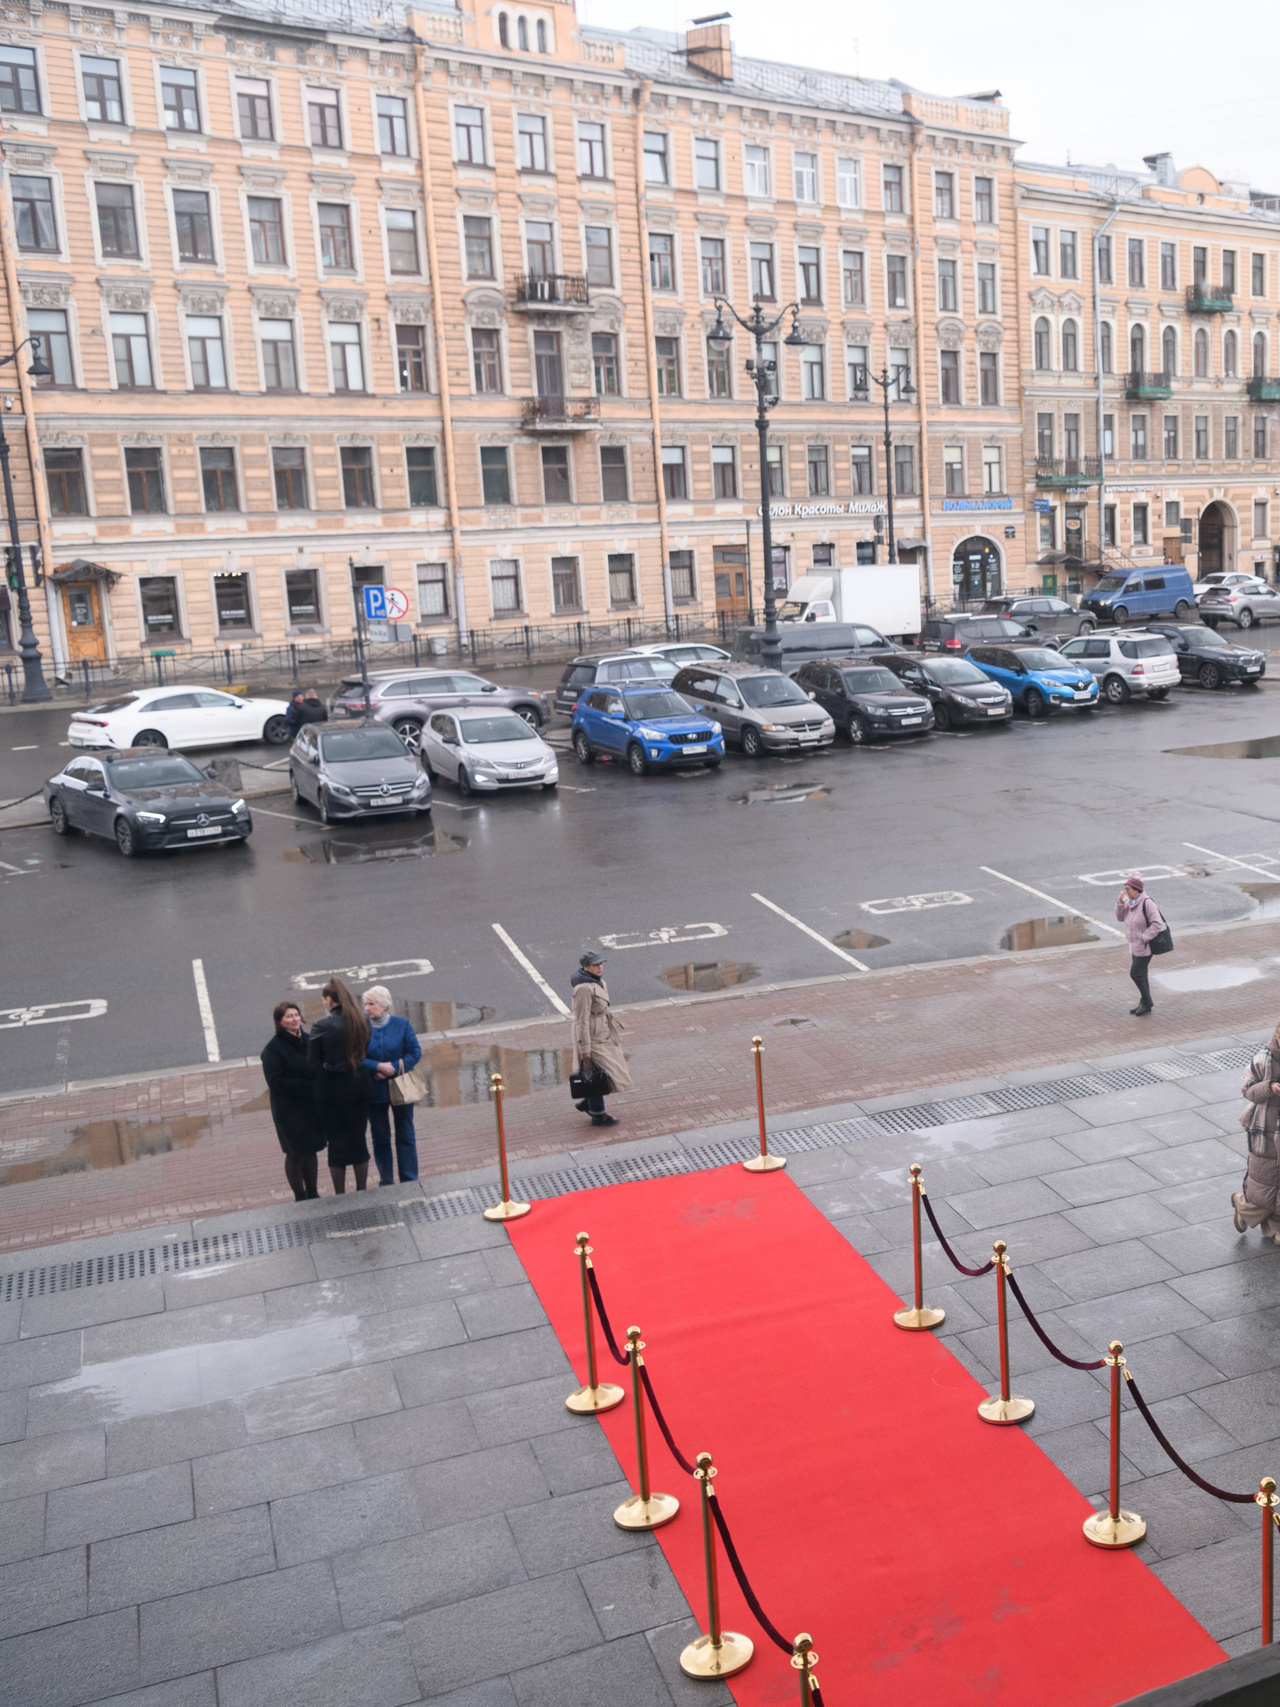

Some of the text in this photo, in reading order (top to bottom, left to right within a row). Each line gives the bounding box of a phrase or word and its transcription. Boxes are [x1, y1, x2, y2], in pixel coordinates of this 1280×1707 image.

[758, 505, 792, 516] Слон
[794, 503, 844, 518] Красоты
[369, 589, 383, 616] P
